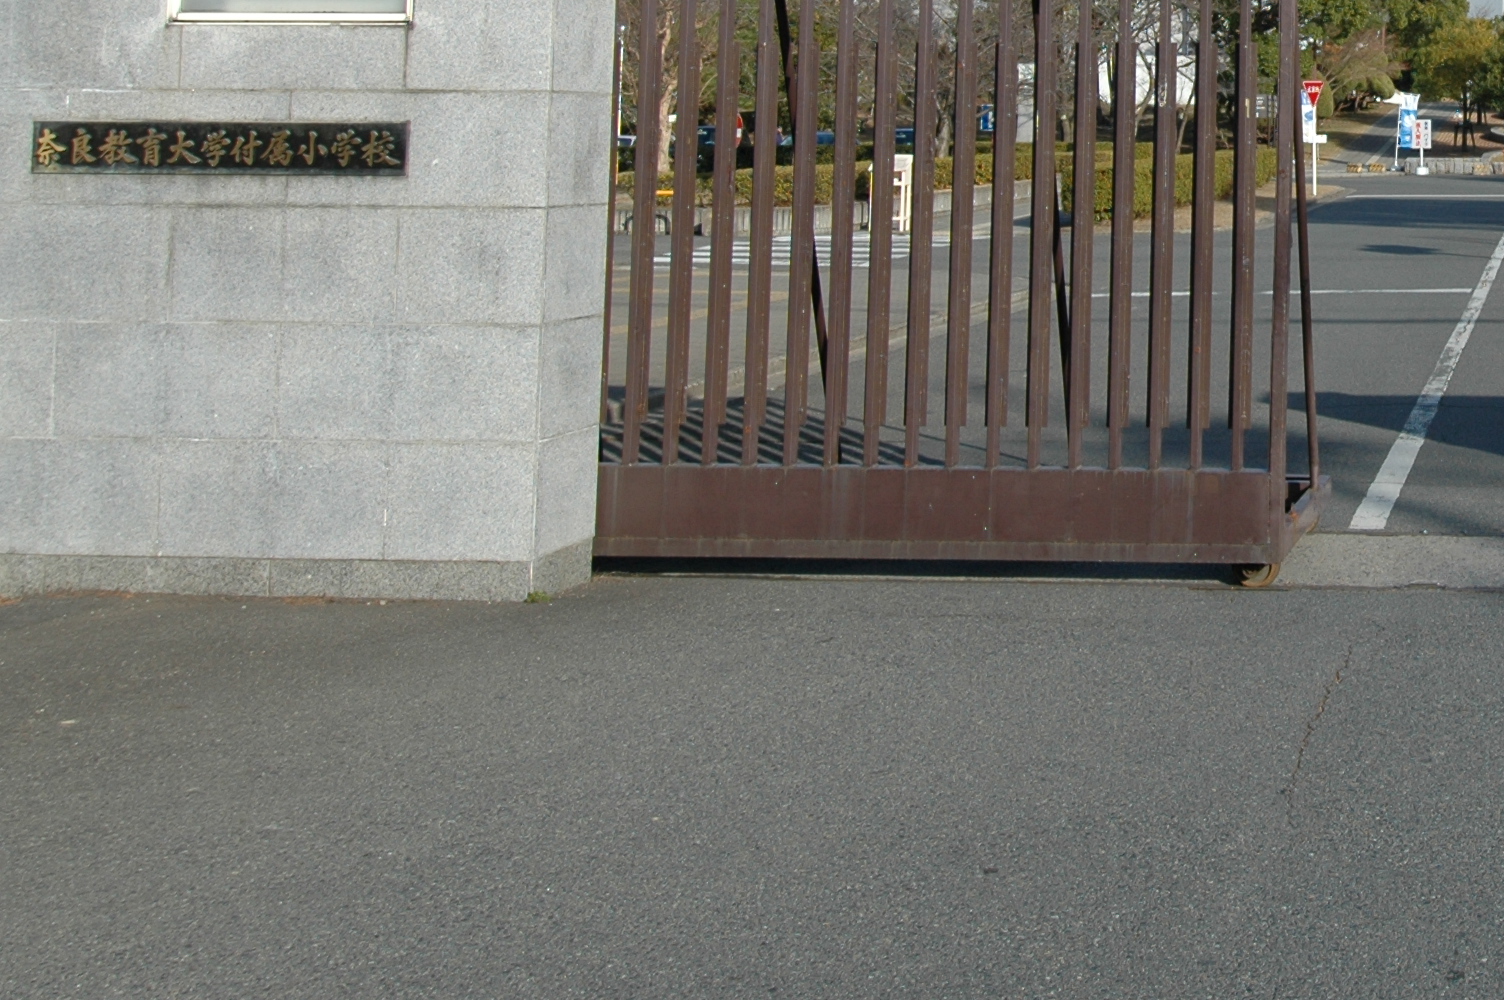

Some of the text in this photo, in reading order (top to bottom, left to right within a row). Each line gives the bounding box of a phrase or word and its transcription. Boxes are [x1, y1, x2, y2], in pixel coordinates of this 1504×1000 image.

[35, 128, 400, 167] 奈良教育大学付属小学校
